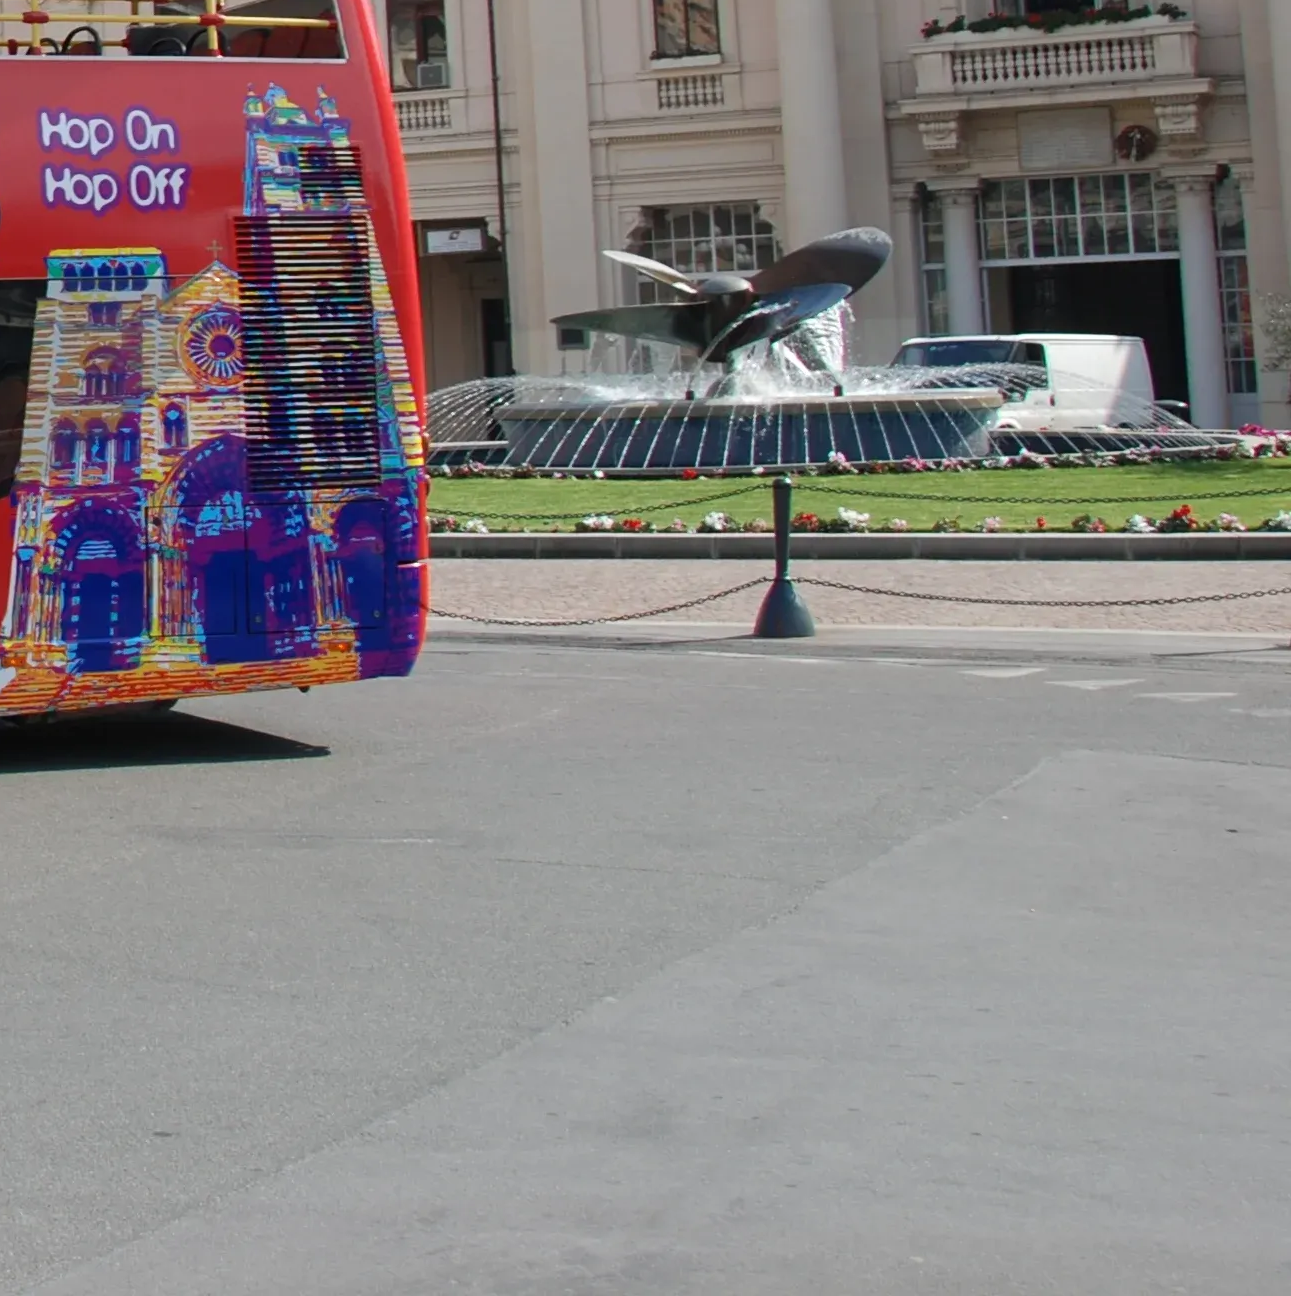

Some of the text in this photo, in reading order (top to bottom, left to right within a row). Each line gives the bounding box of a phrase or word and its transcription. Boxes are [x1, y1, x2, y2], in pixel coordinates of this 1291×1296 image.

[40, 109, 175, 155] Hop On
[44, 164, 186, 211] Hop Off
